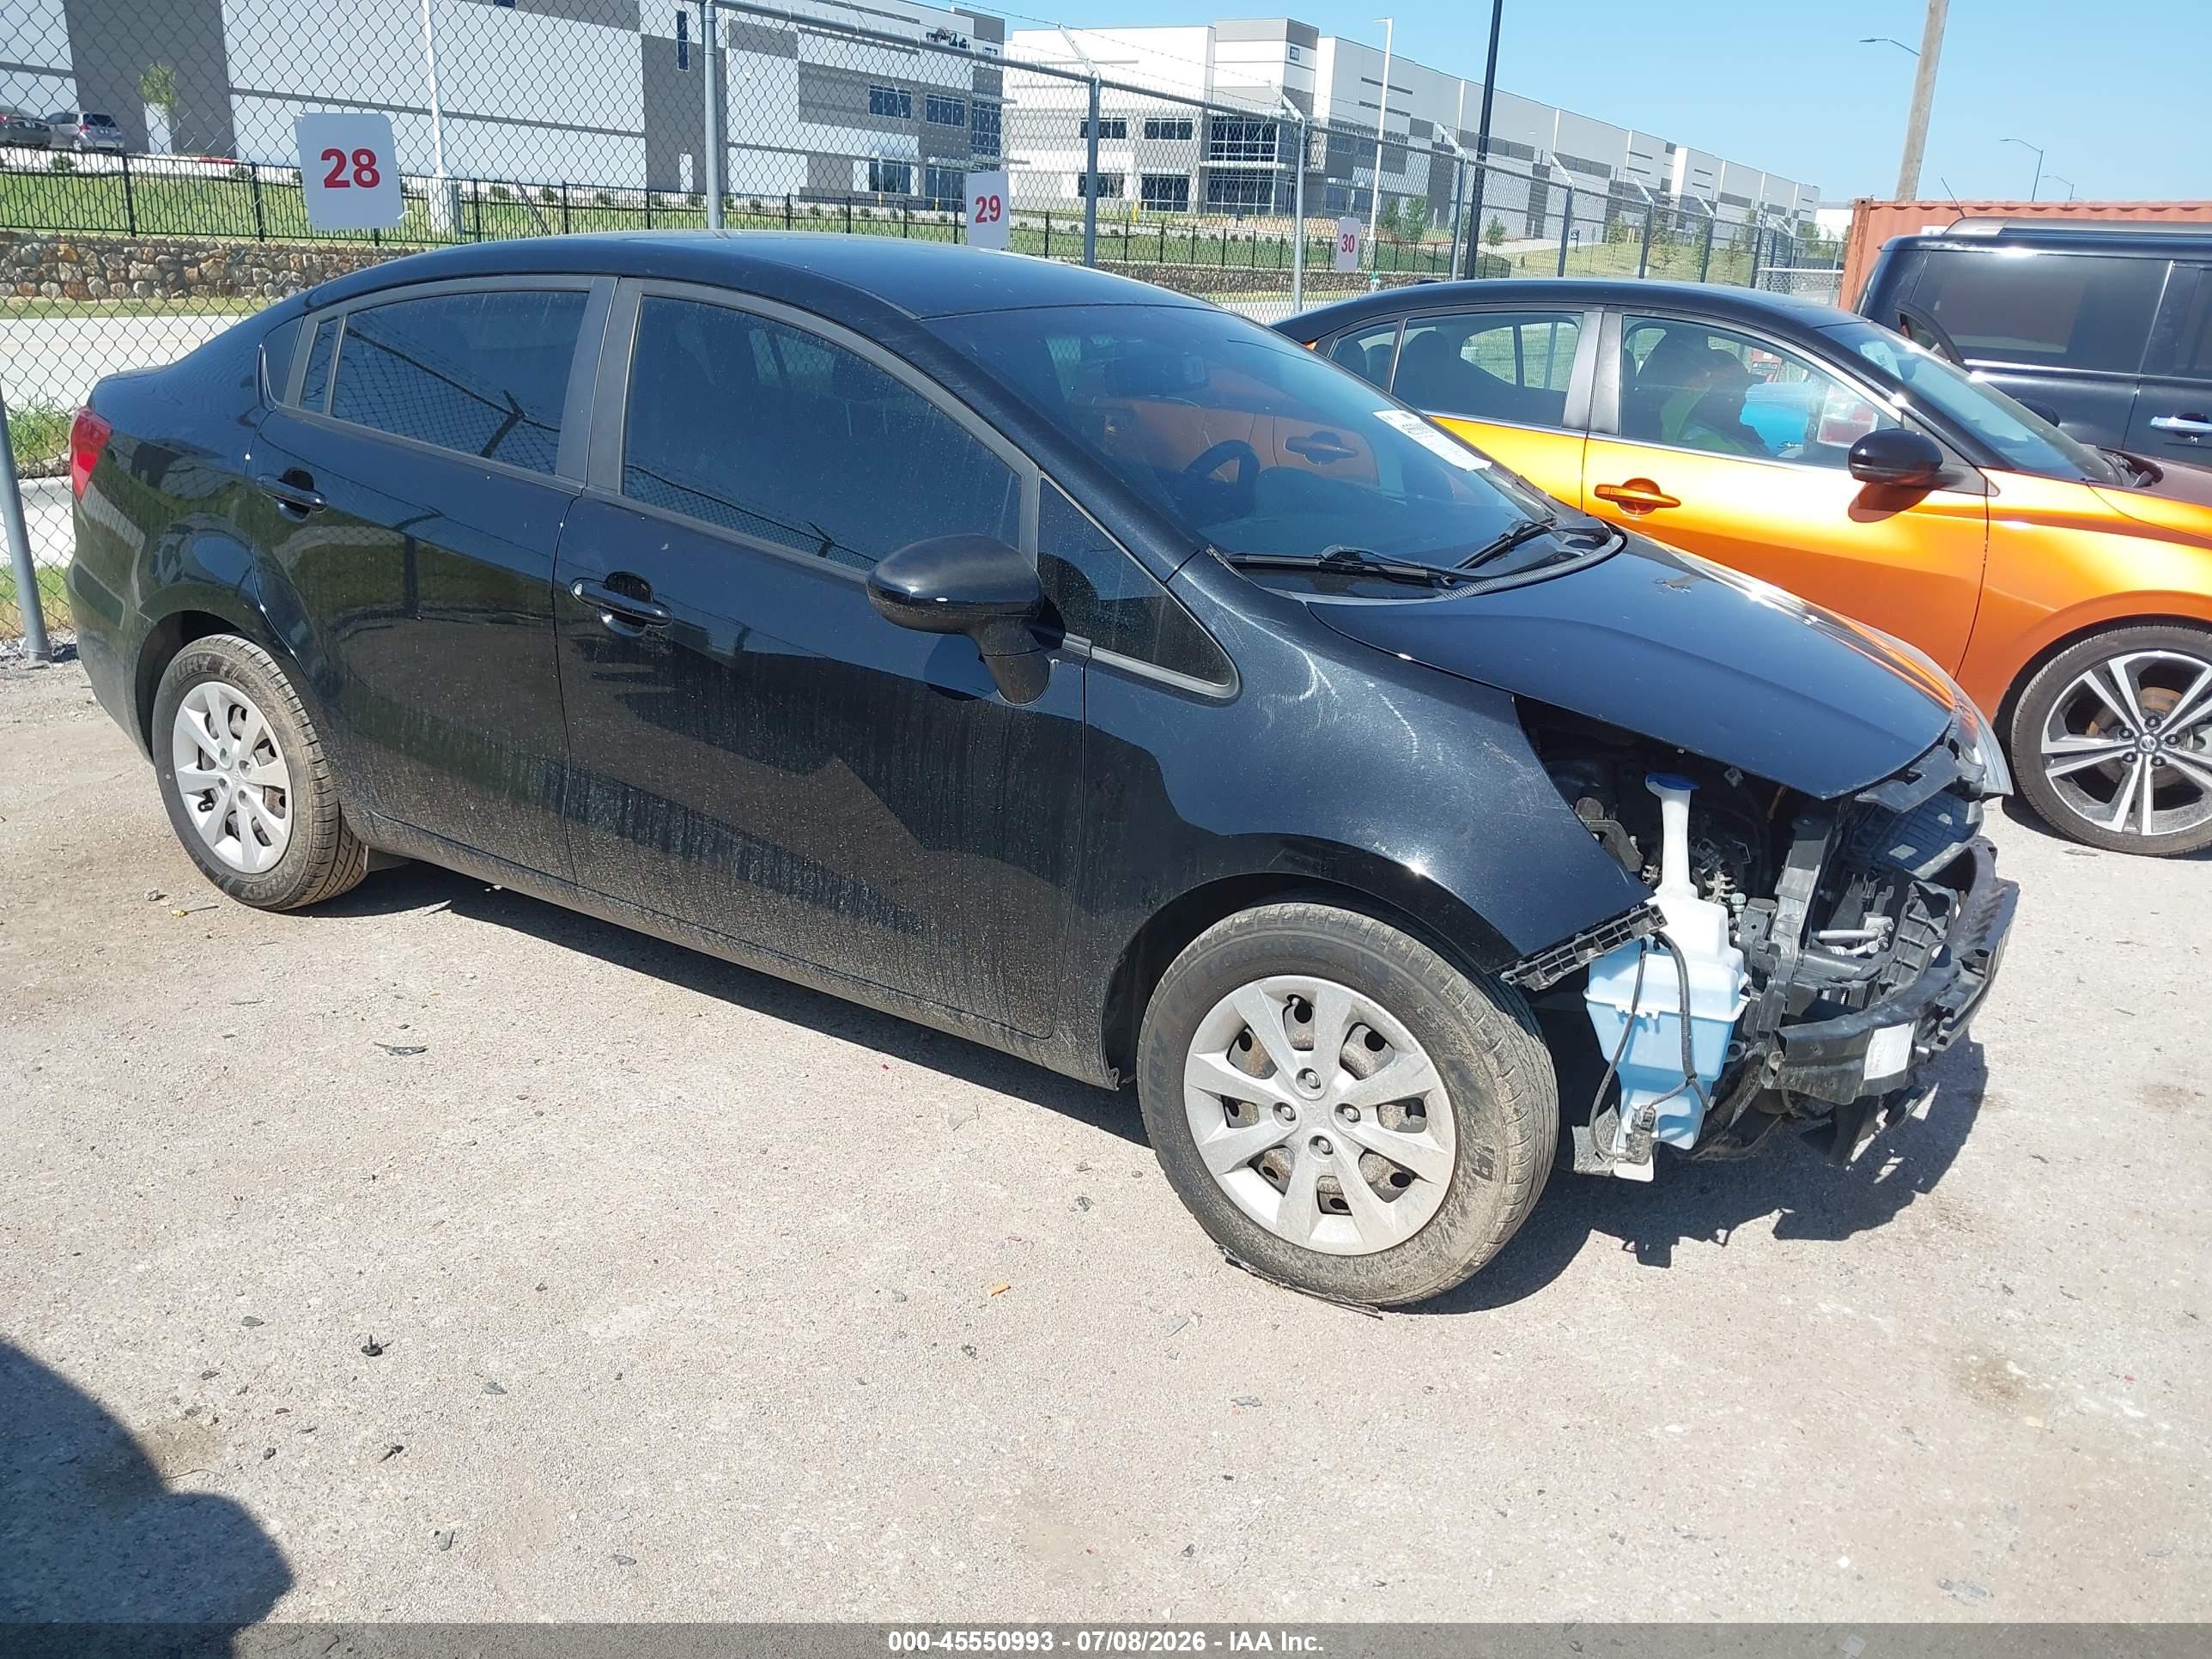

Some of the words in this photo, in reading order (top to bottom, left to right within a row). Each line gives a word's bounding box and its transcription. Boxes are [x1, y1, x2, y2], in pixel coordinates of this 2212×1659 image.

[321, 148, 380, 189] 28
[975, 194, 1001, 223] 29
[1340, 233, 1355, 253] 30
